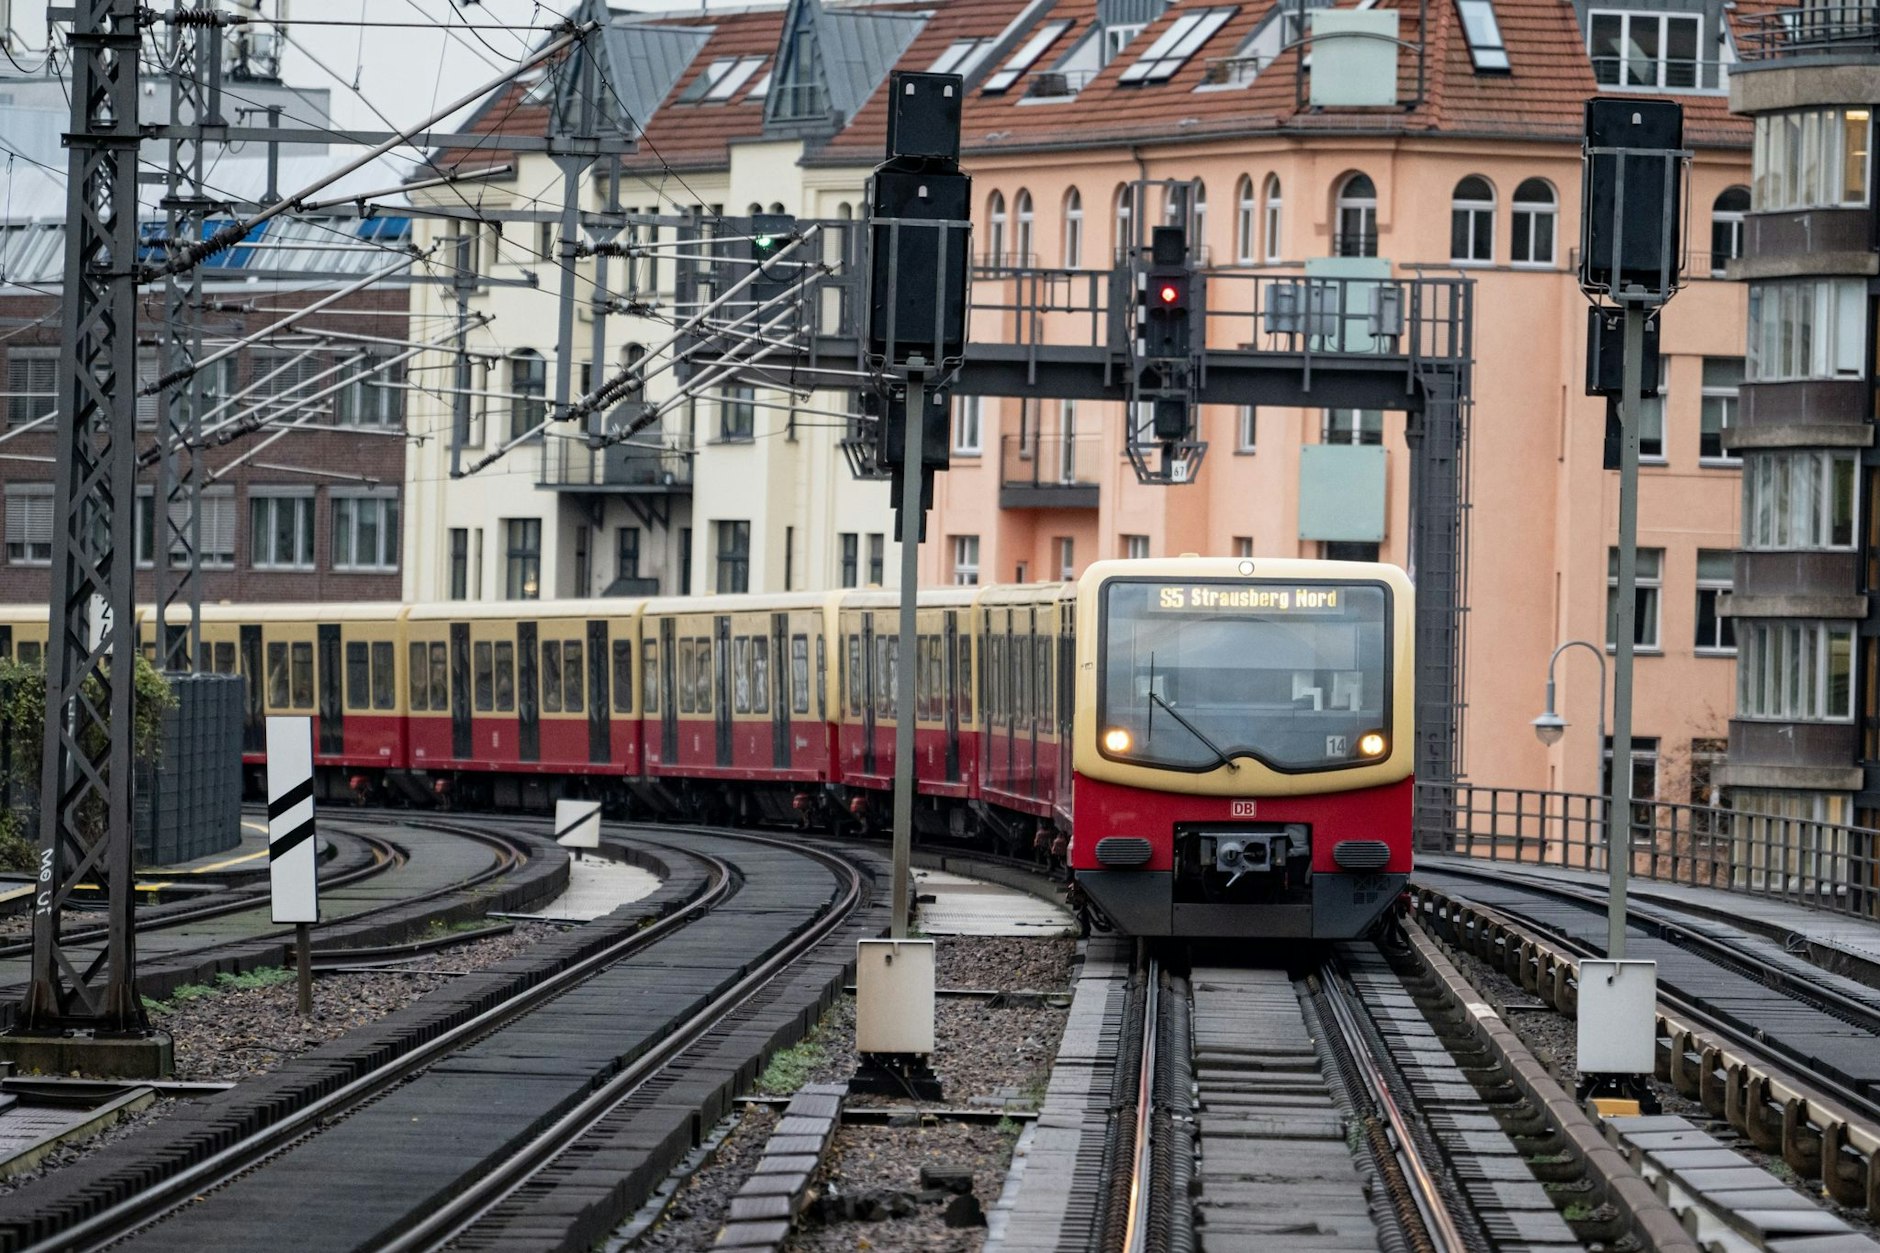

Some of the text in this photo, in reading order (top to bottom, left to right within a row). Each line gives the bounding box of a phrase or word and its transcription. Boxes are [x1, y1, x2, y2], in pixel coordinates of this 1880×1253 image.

[1173, 466, 1185, 477] 67
[1160, 587, 1337, 610] S5 Strausberg Nord
[1329, 737, 1346, 755] 14
[1234, 802, 1254, 815] DB
